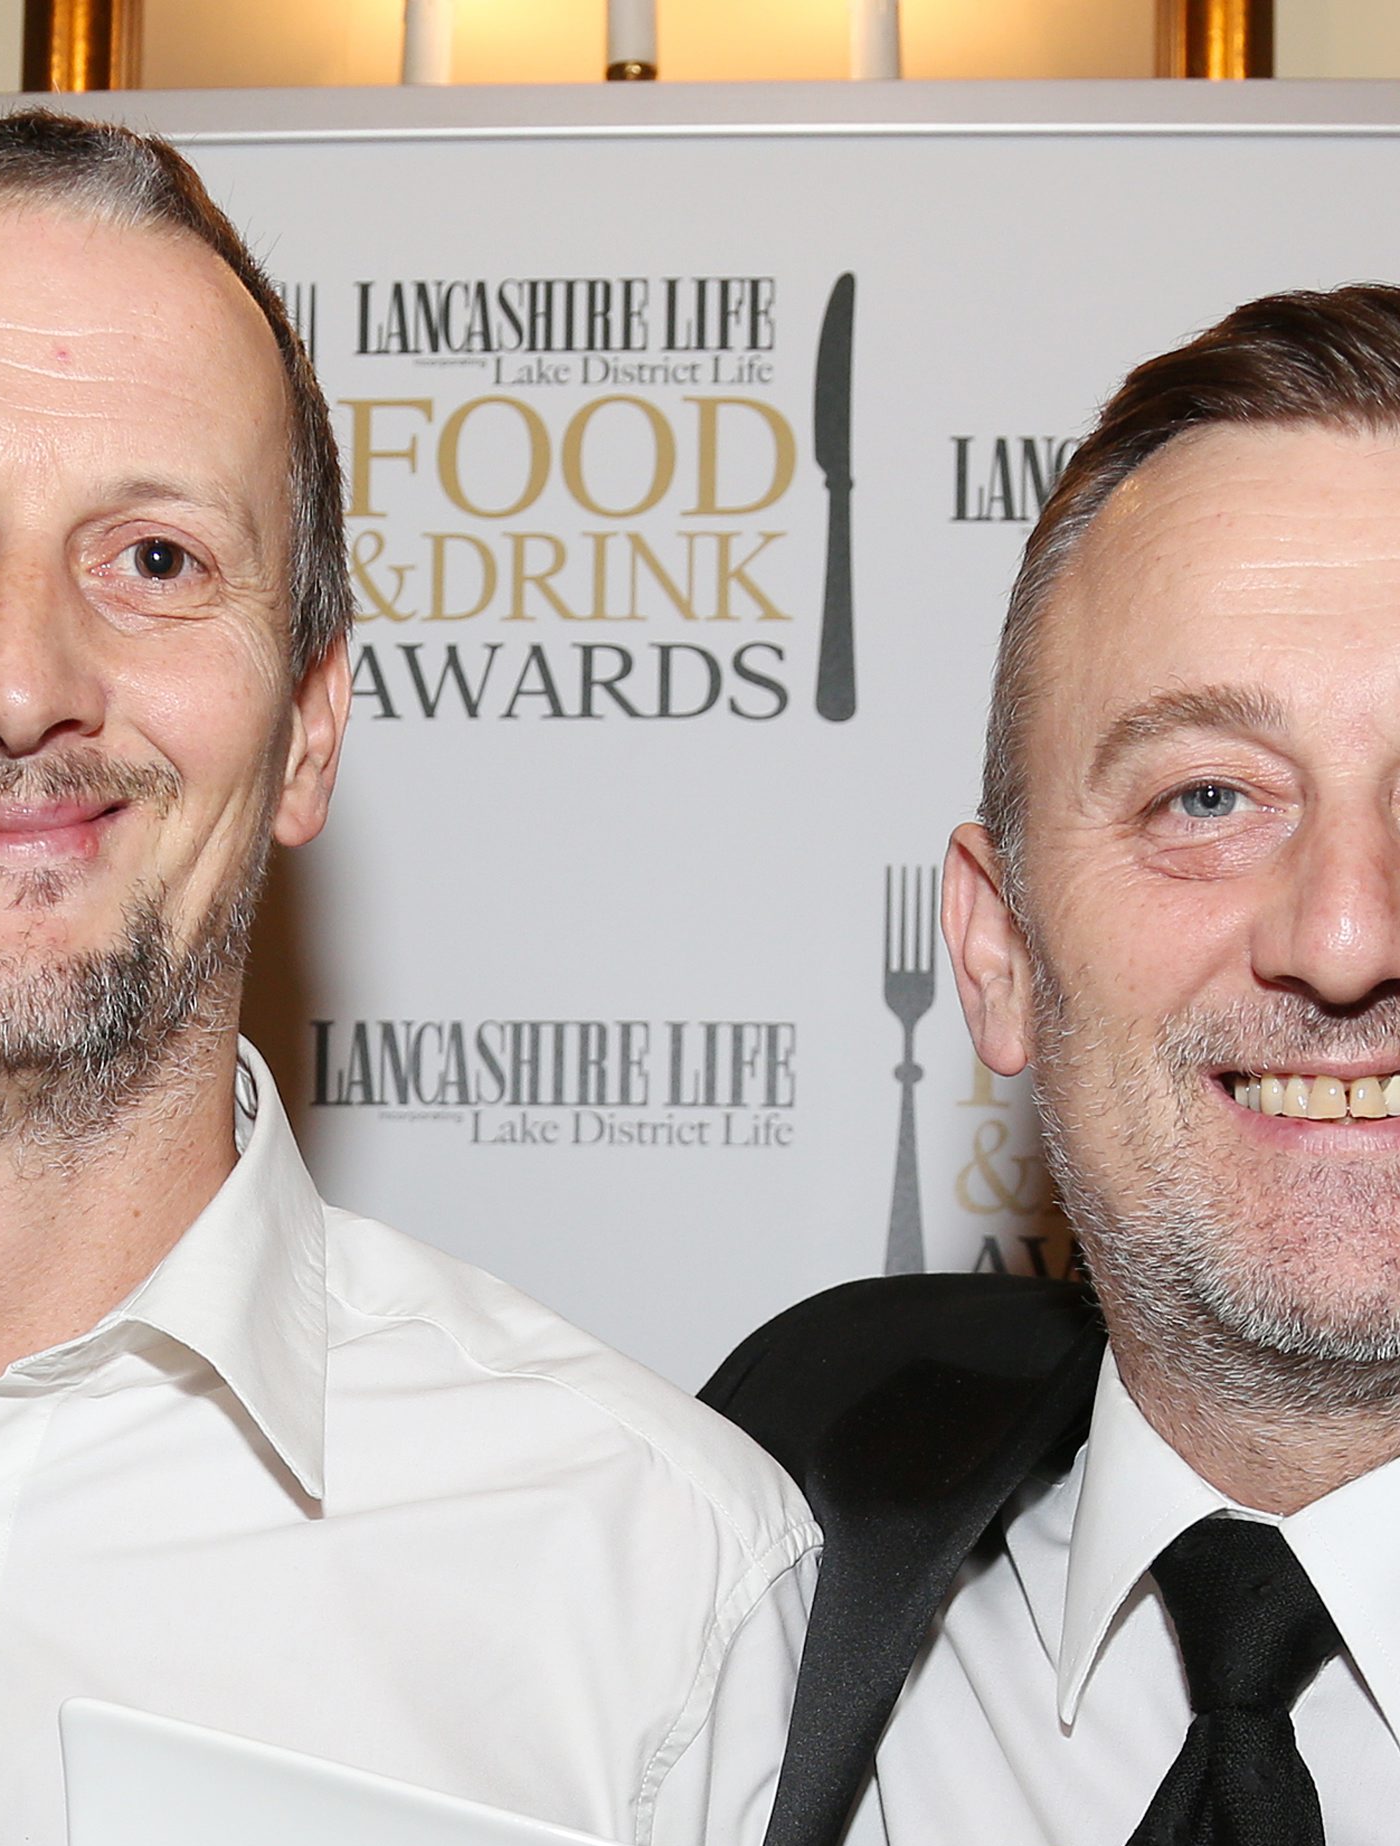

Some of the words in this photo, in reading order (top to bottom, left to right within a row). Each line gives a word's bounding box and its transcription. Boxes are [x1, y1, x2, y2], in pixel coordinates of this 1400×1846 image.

[354, 277, 648, 355] LANCASHIRE
[661, 276, 775, 352] LIFE
[493, 356, 570, 386] Lake
[581, 356, 701, 386] District
[711, 355, 773, 385] Life
[336, 395, 798, 519] FOOD
[350, 530, 793, 623] &DRINK
[350, 641, 789, 722] AWARDS
[309, 1019, 649, 1107] LANCASHIRE
[664, 1020, 796, 1108] LIFE
[470, 1110, 559, 1145] Lake
[572, 1110, 710, 1146] District
[720, 1110, 794, 1147] Life
